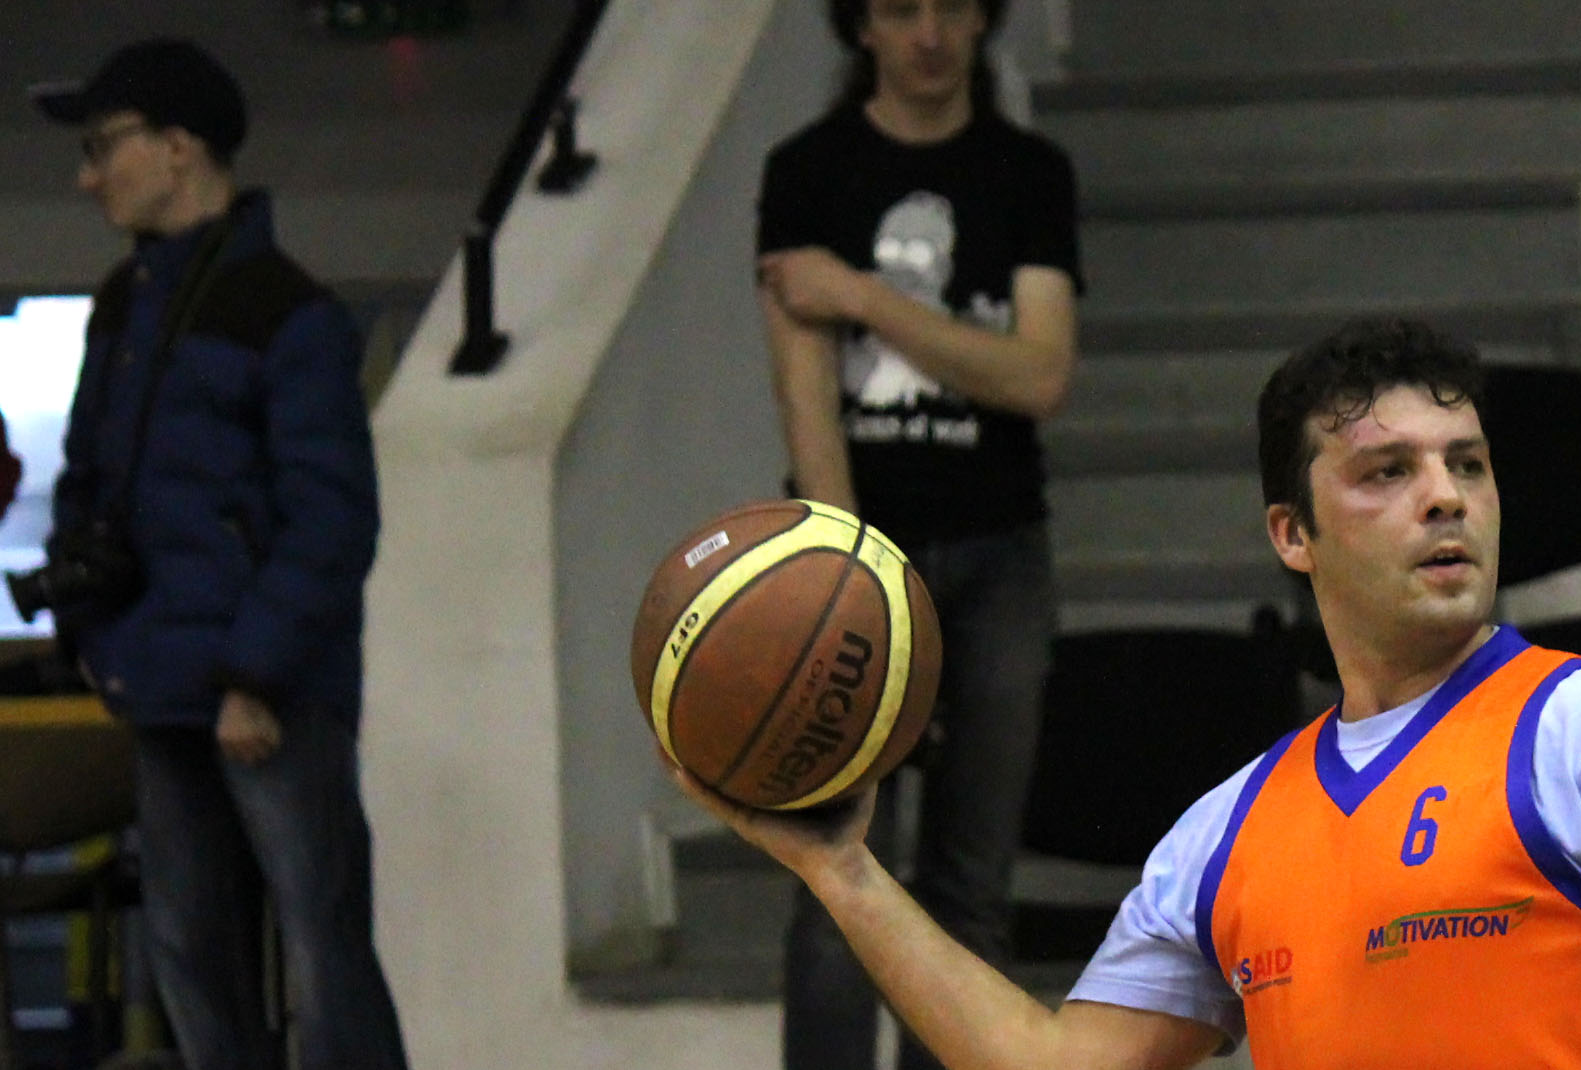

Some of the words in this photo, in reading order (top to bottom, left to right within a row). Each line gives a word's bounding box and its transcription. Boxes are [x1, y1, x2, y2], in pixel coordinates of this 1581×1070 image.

[758, 630, 873, 793] molten
[1400, 785, 1448, 867] 6
[1365, 912, 1510, 953] MOTIVATION
[1239, 947, 1294, 985] SAID
